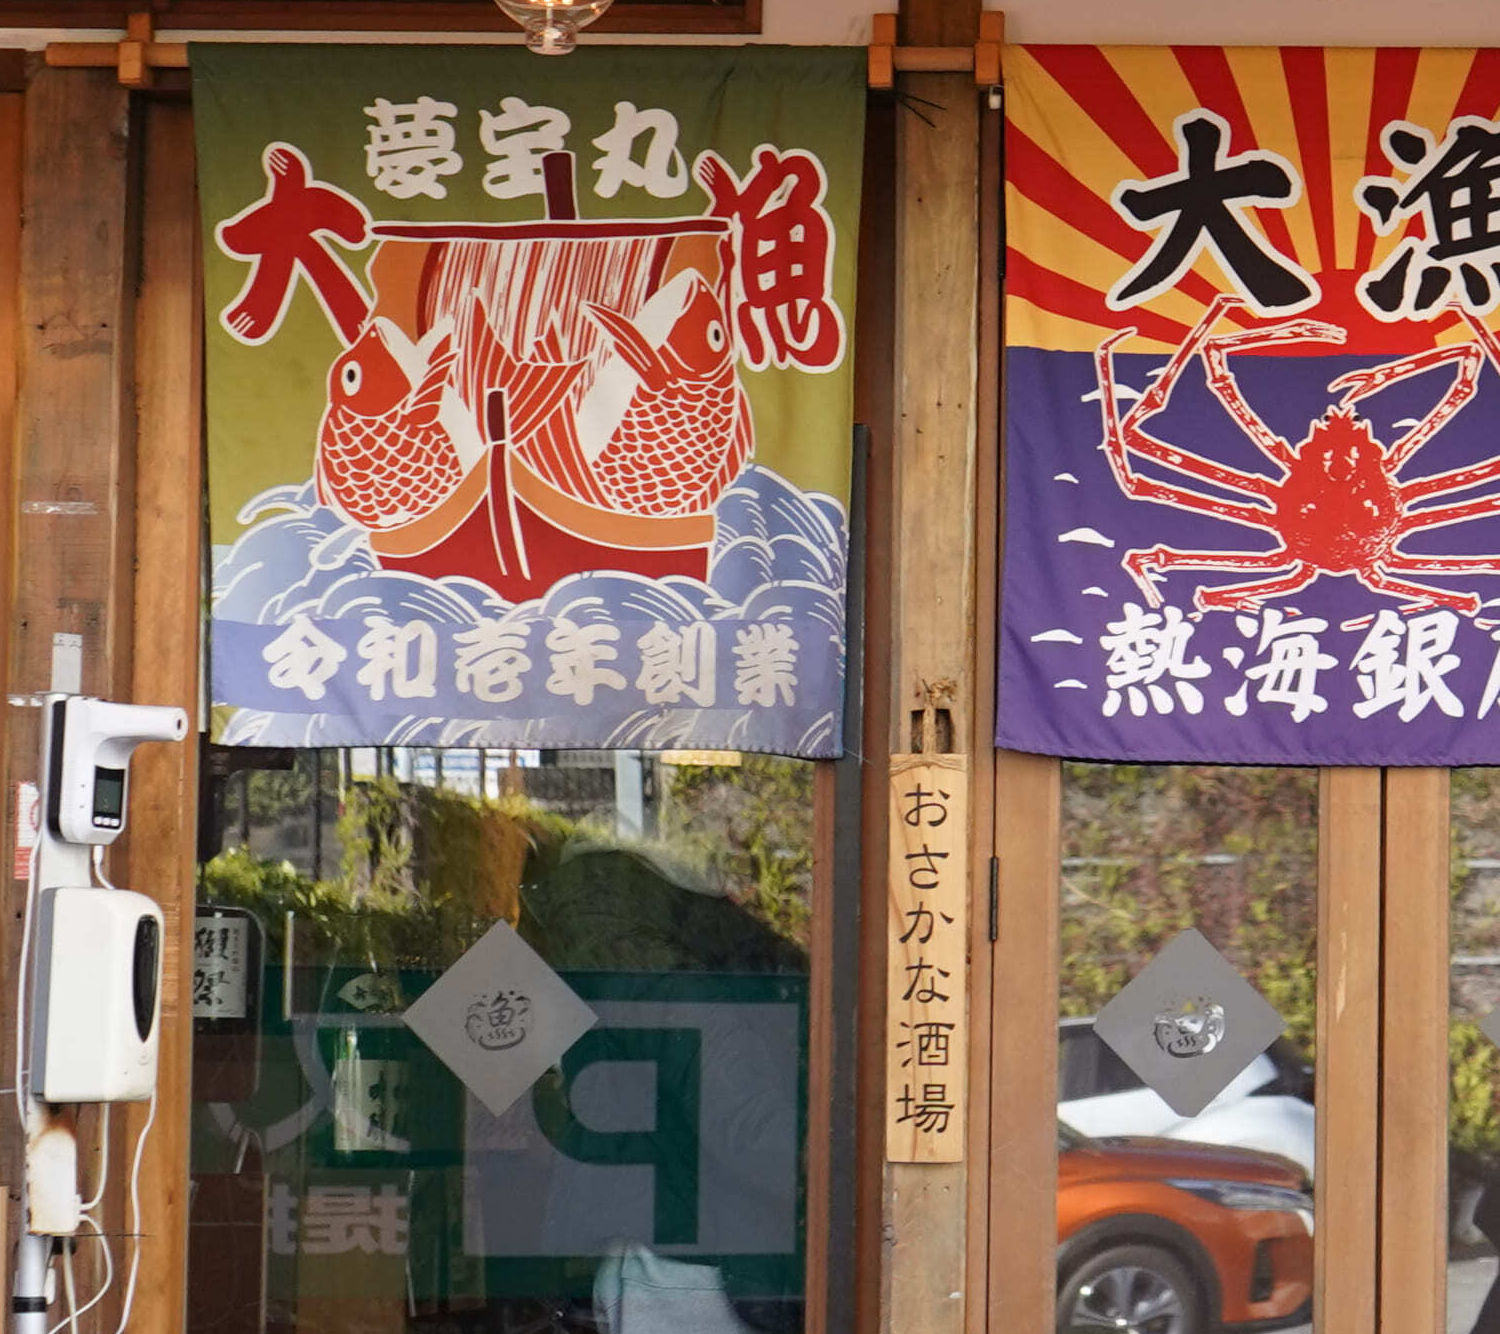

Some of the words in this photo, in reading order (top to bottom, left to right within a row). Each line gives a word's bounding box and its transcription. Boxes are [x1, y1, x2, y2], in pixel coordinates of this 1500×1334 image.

[216, 142, 373, 346] 大
[262, 615, 797, 708] 令和壱年創業
[897, 782, 955, 1134] おさかな酒場
